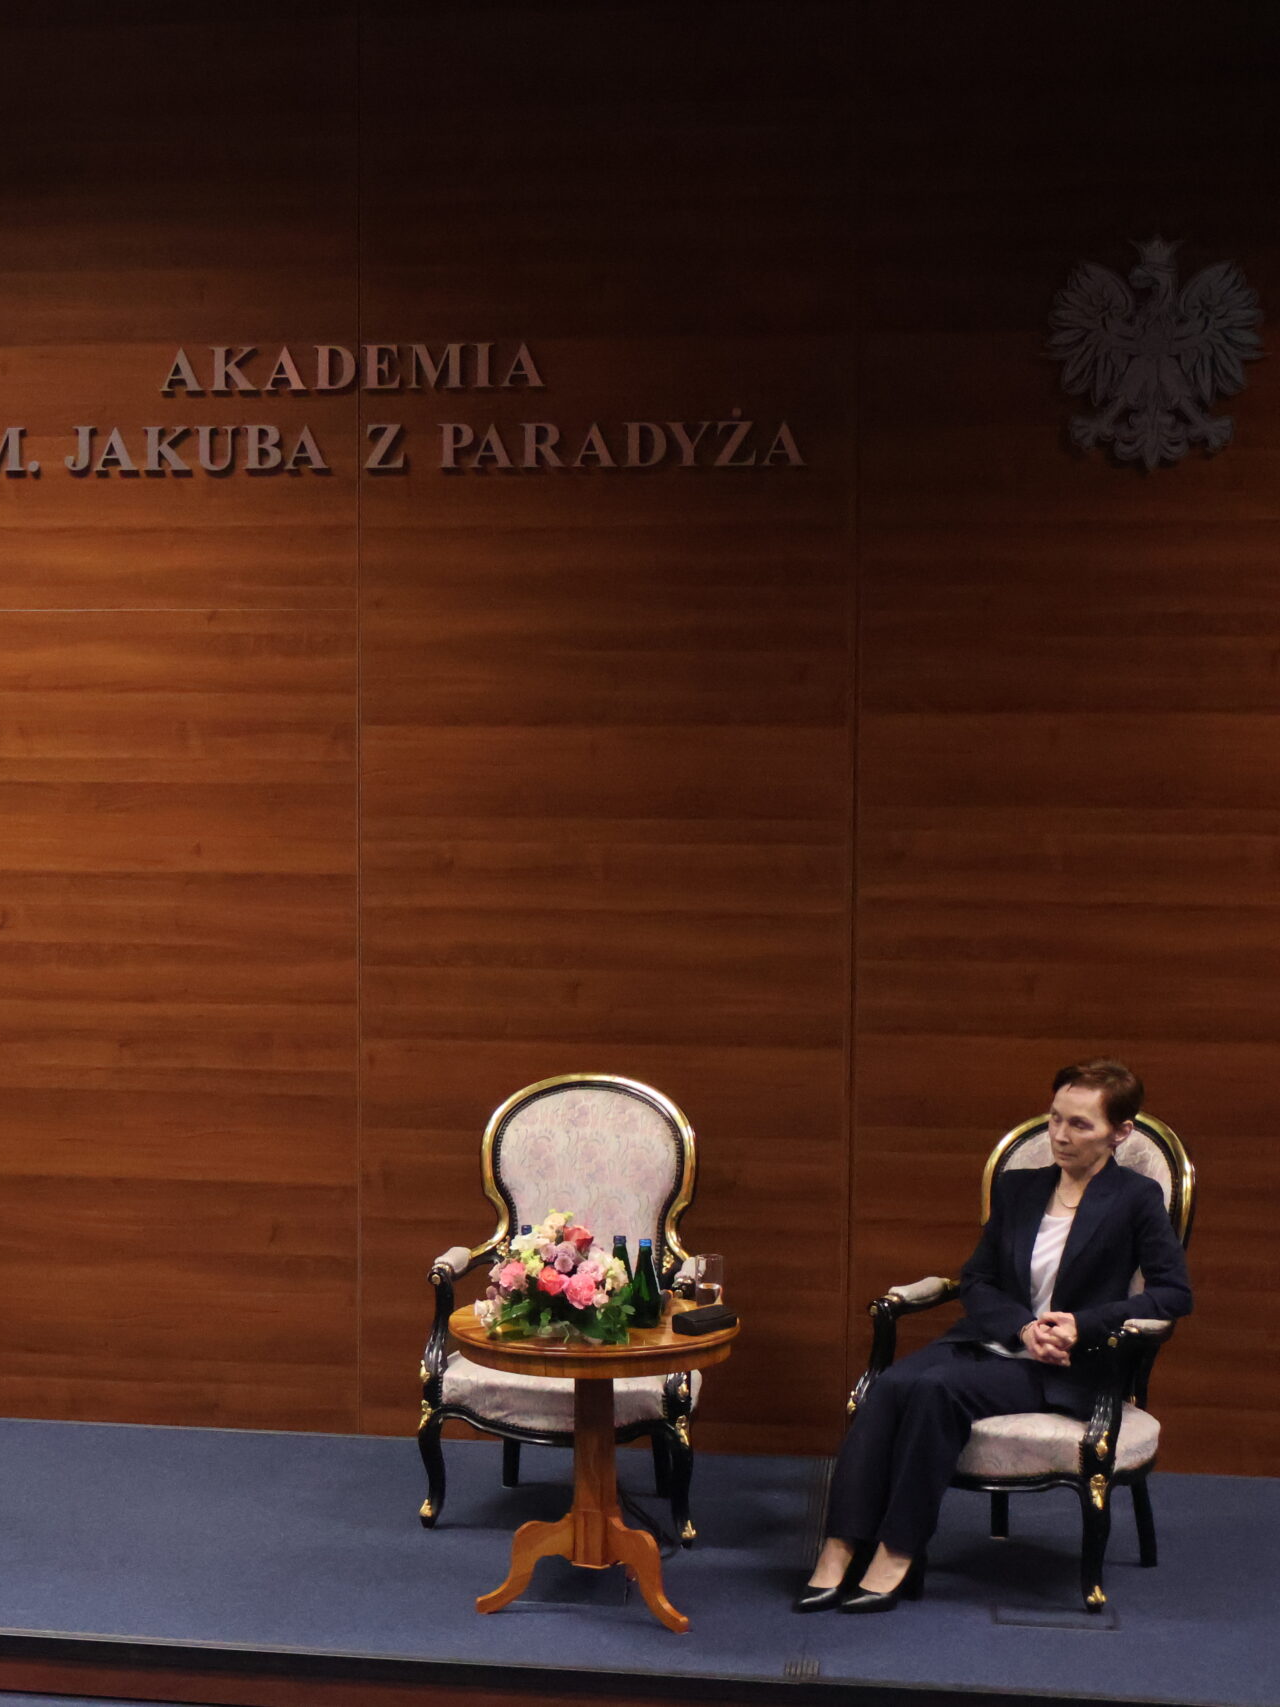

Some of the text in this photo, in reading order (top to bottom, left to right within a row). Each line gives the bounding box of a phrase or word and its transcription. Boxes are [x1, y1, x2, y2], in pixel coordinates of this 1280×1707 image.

[159, 342, 546, 393] AKADEMIA
[63, 424, 331, 472] JAKUBA
[364, 423, 408, 469] Z
[436, 407, 809, 468] PARADYŻA
